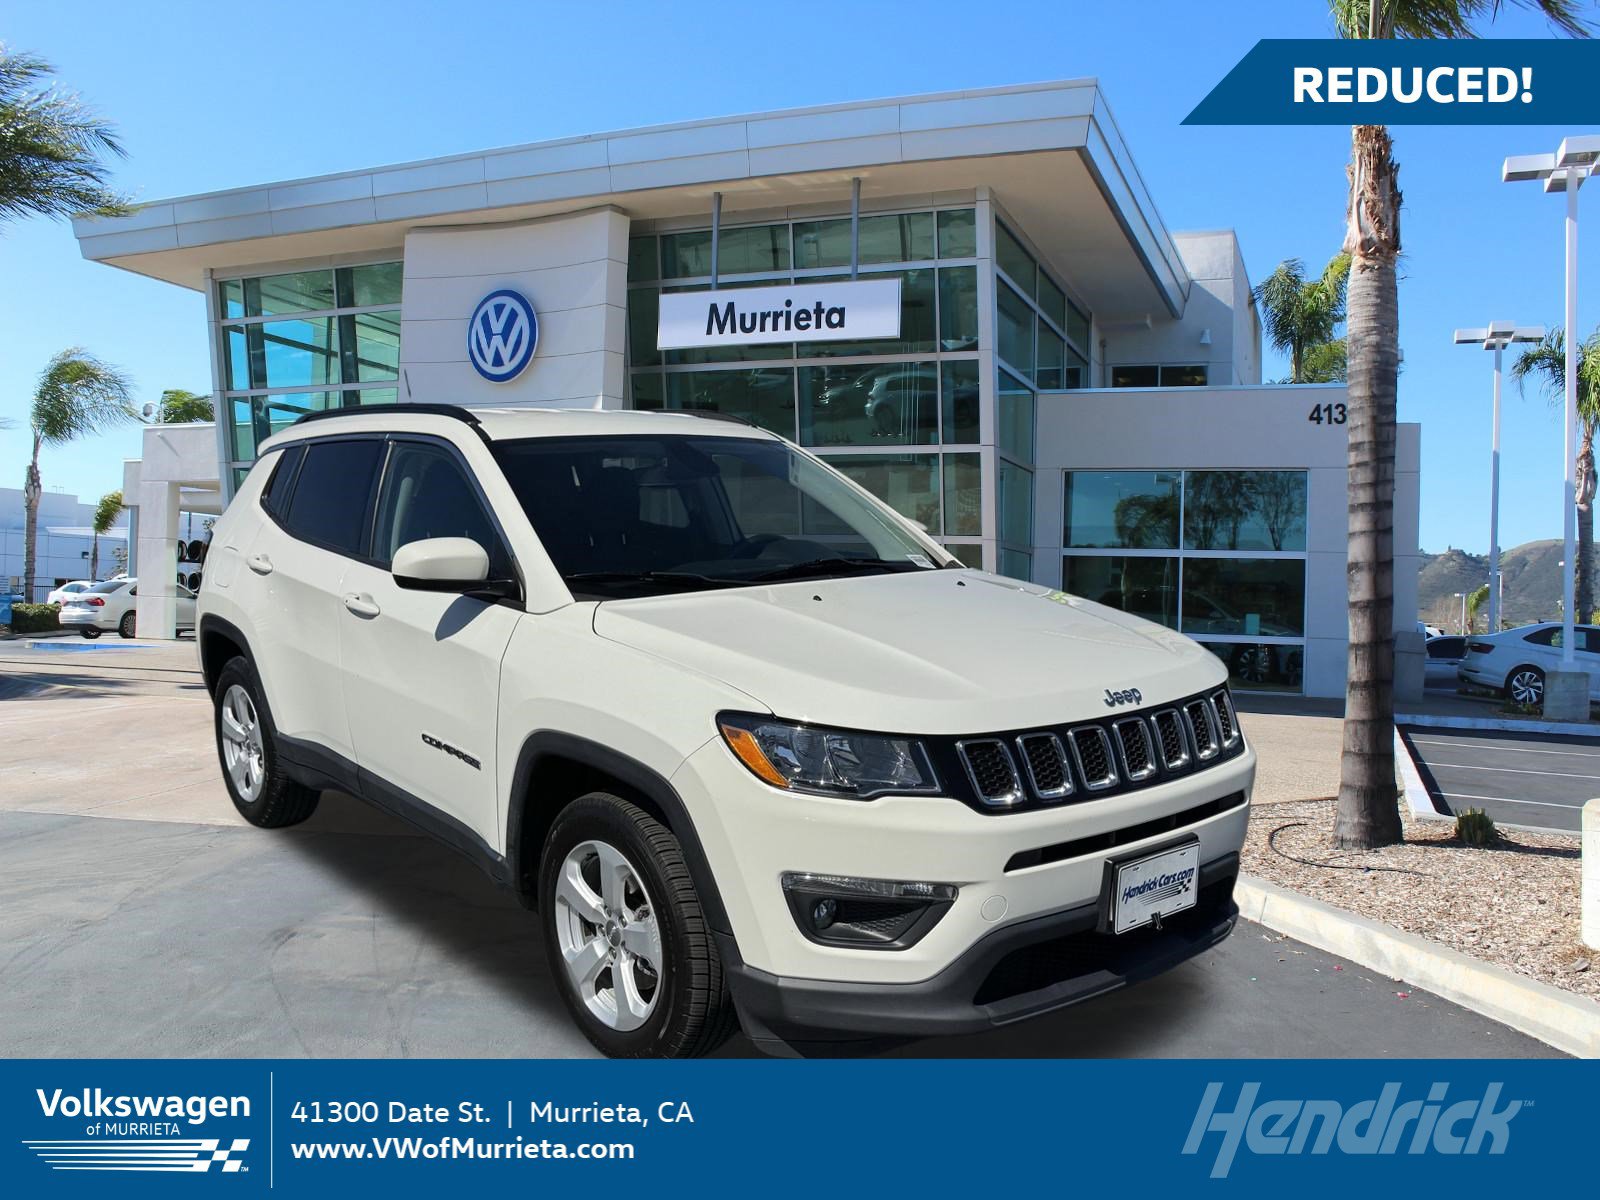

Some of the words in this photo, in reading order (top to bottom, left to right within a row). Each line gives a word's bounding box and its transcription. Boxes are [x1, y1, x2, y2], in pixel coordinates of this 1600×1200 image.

[705, 299, 846, 336] Murrieta
[1103, 687, 1142, 707] Jeep
[421, 733, 481, 771] COMPASS
